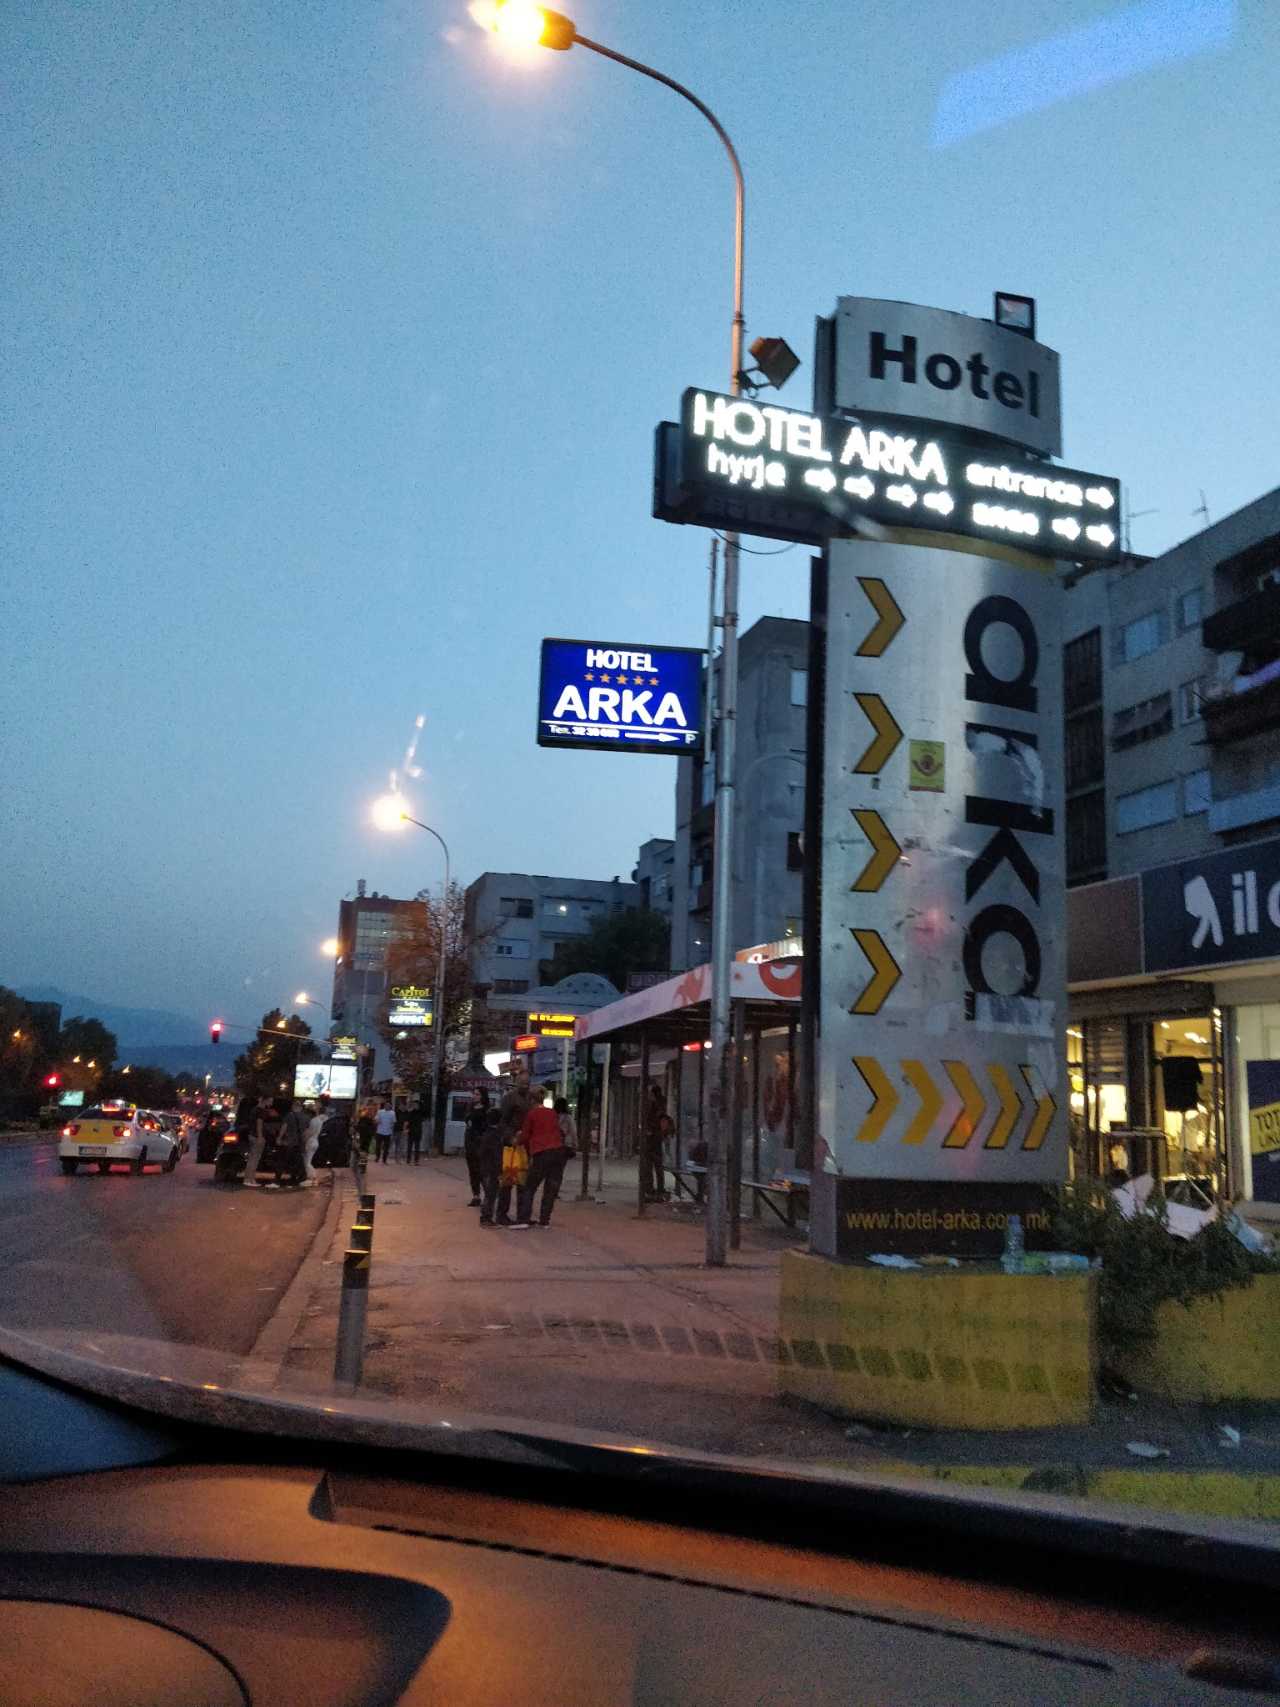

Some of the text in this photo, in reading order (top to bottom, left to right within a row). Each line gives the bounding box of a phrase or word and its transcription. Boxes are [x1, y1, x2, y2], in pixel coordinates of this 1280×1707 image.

[869, 331, 1041, 419] Hotel
[693, 393, 948, 486] HOTEL ARKA
[707, 442, 786, 489] hyrje
[586, 648, 659, 673] HOTEL
[552, 684, 688, 727] ARKA
